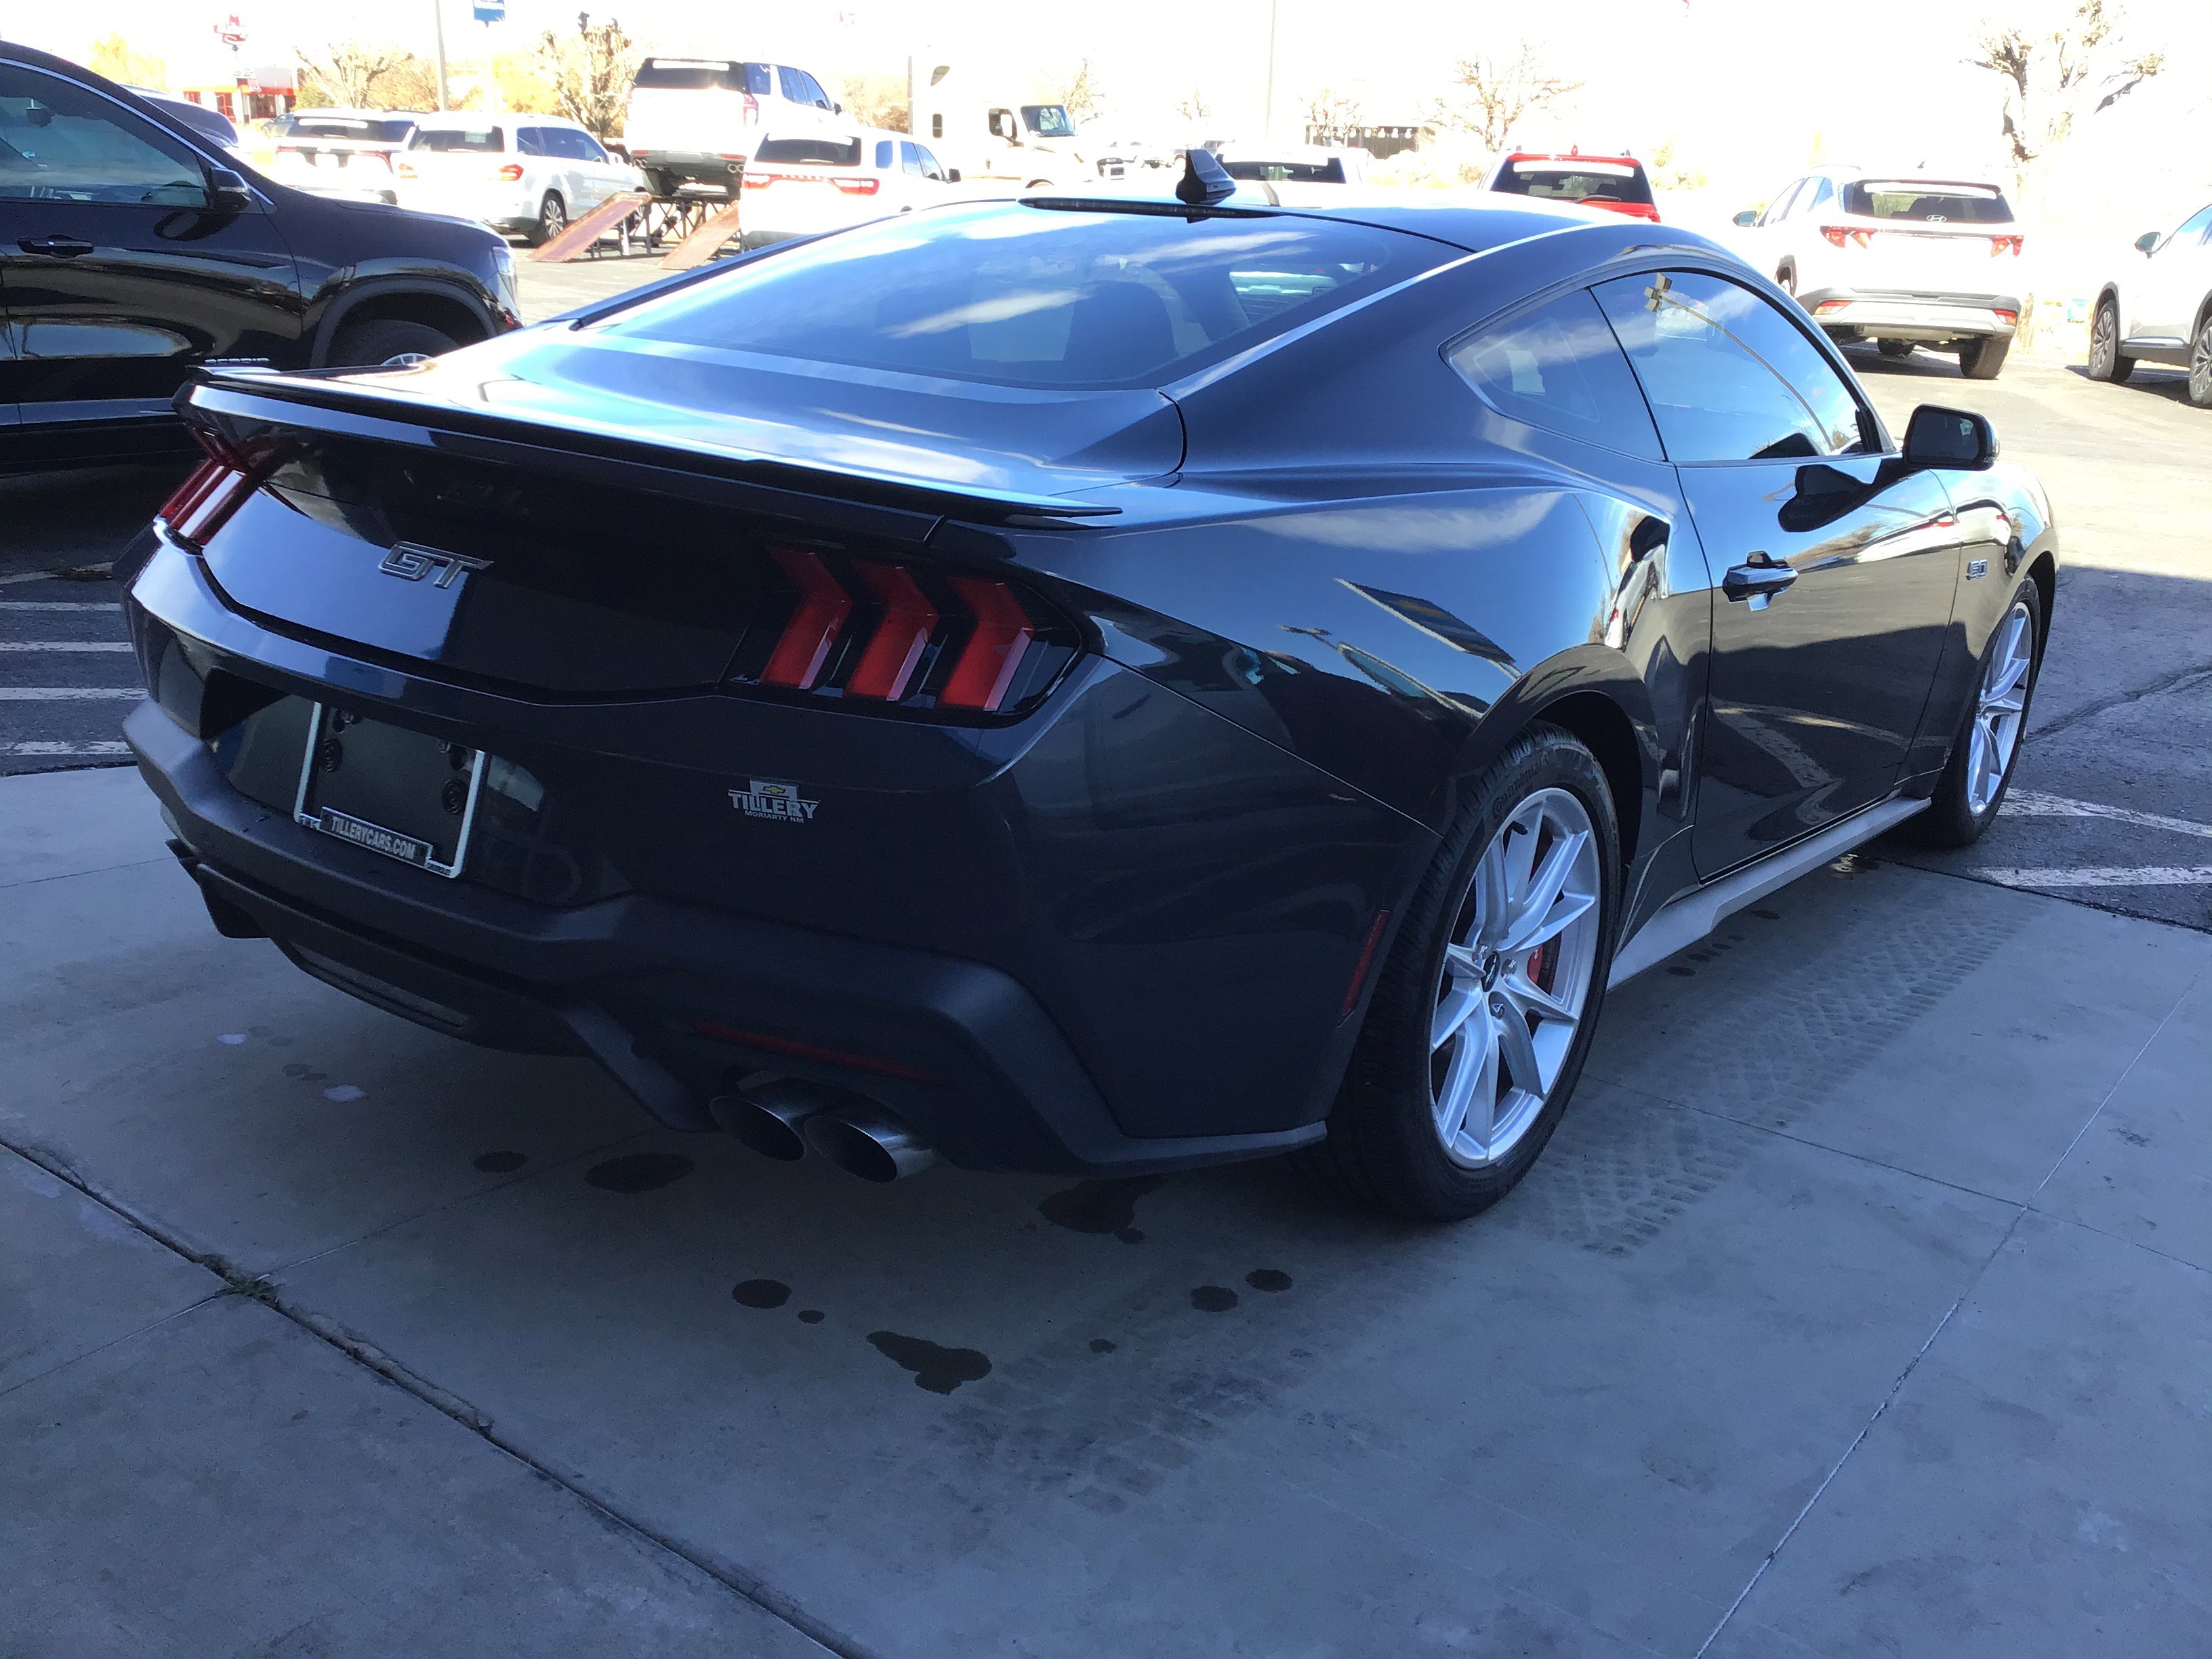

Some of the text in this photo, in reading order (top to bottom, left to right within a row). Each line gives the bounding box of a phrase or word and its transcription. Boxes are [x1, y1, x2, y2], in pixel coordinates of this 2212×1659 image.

[377, 541, 495, 590] GT
[728, 792, 818, 819] TILLERY
[744, 810, 787, 821] MORIARTY
[331, 816, 416, 859] TILLERYCARS.COM
